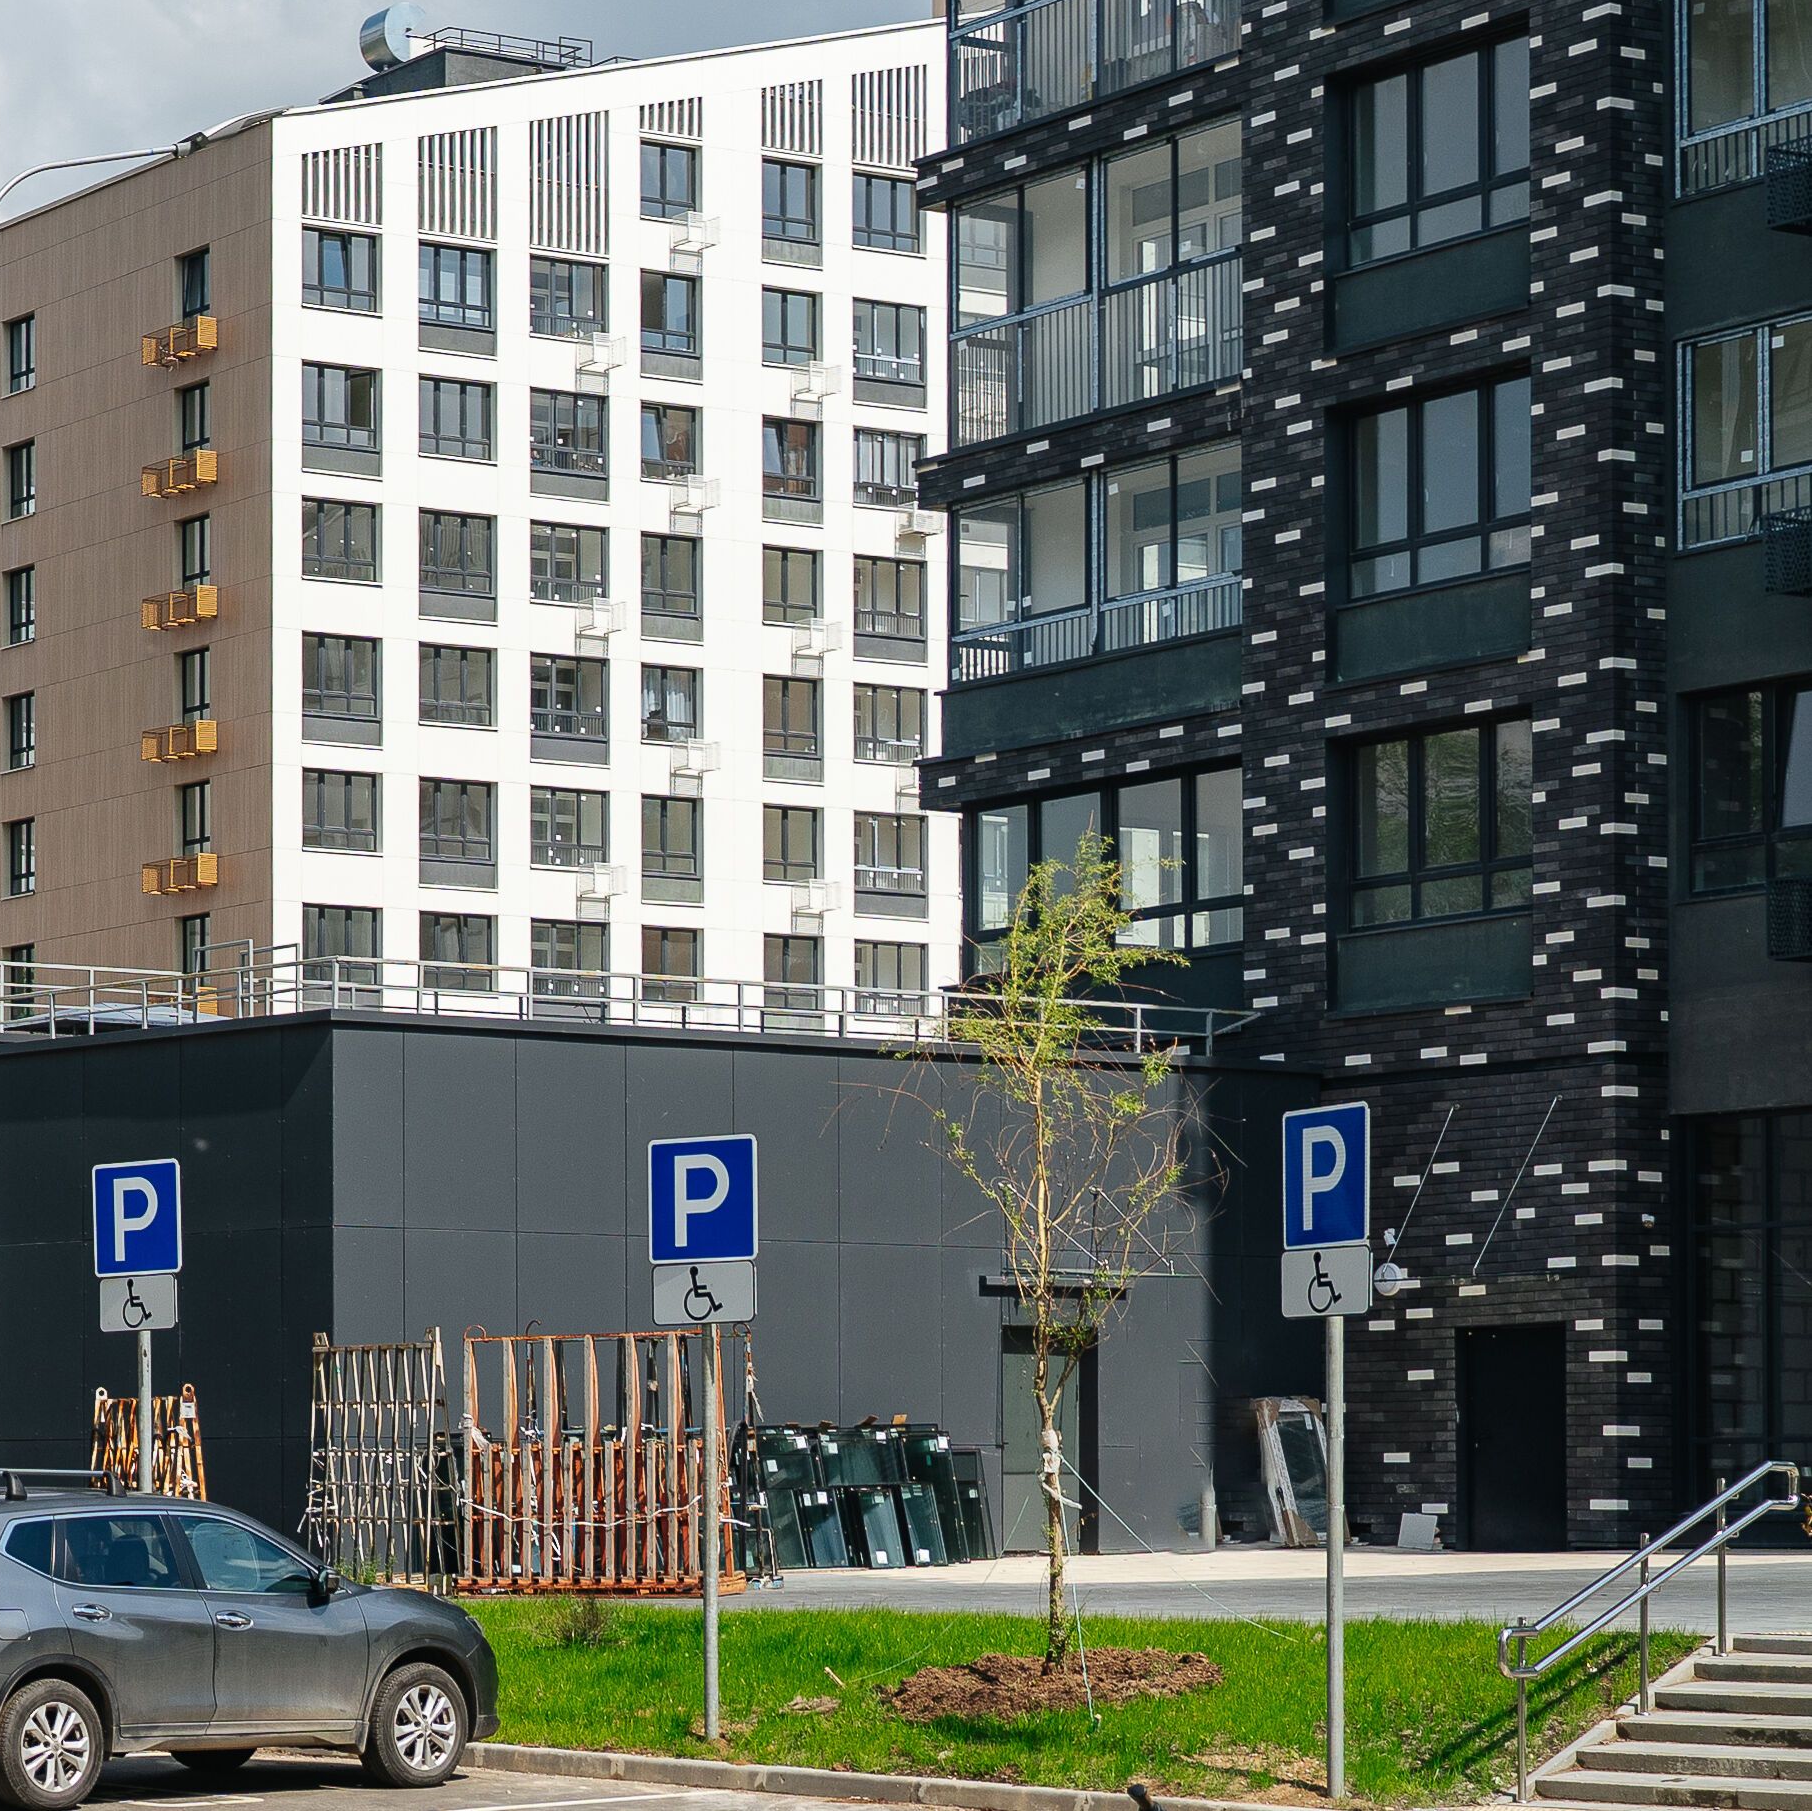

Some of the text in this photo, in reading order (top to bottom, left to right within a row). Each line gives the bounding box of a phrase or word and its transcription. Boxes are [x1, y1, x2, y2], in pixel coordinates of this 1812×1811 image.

[113, 1176, 158, 1262] P
[674, 1154, 730, 1247] P
[1303, 1125, 1346, 1231] P
